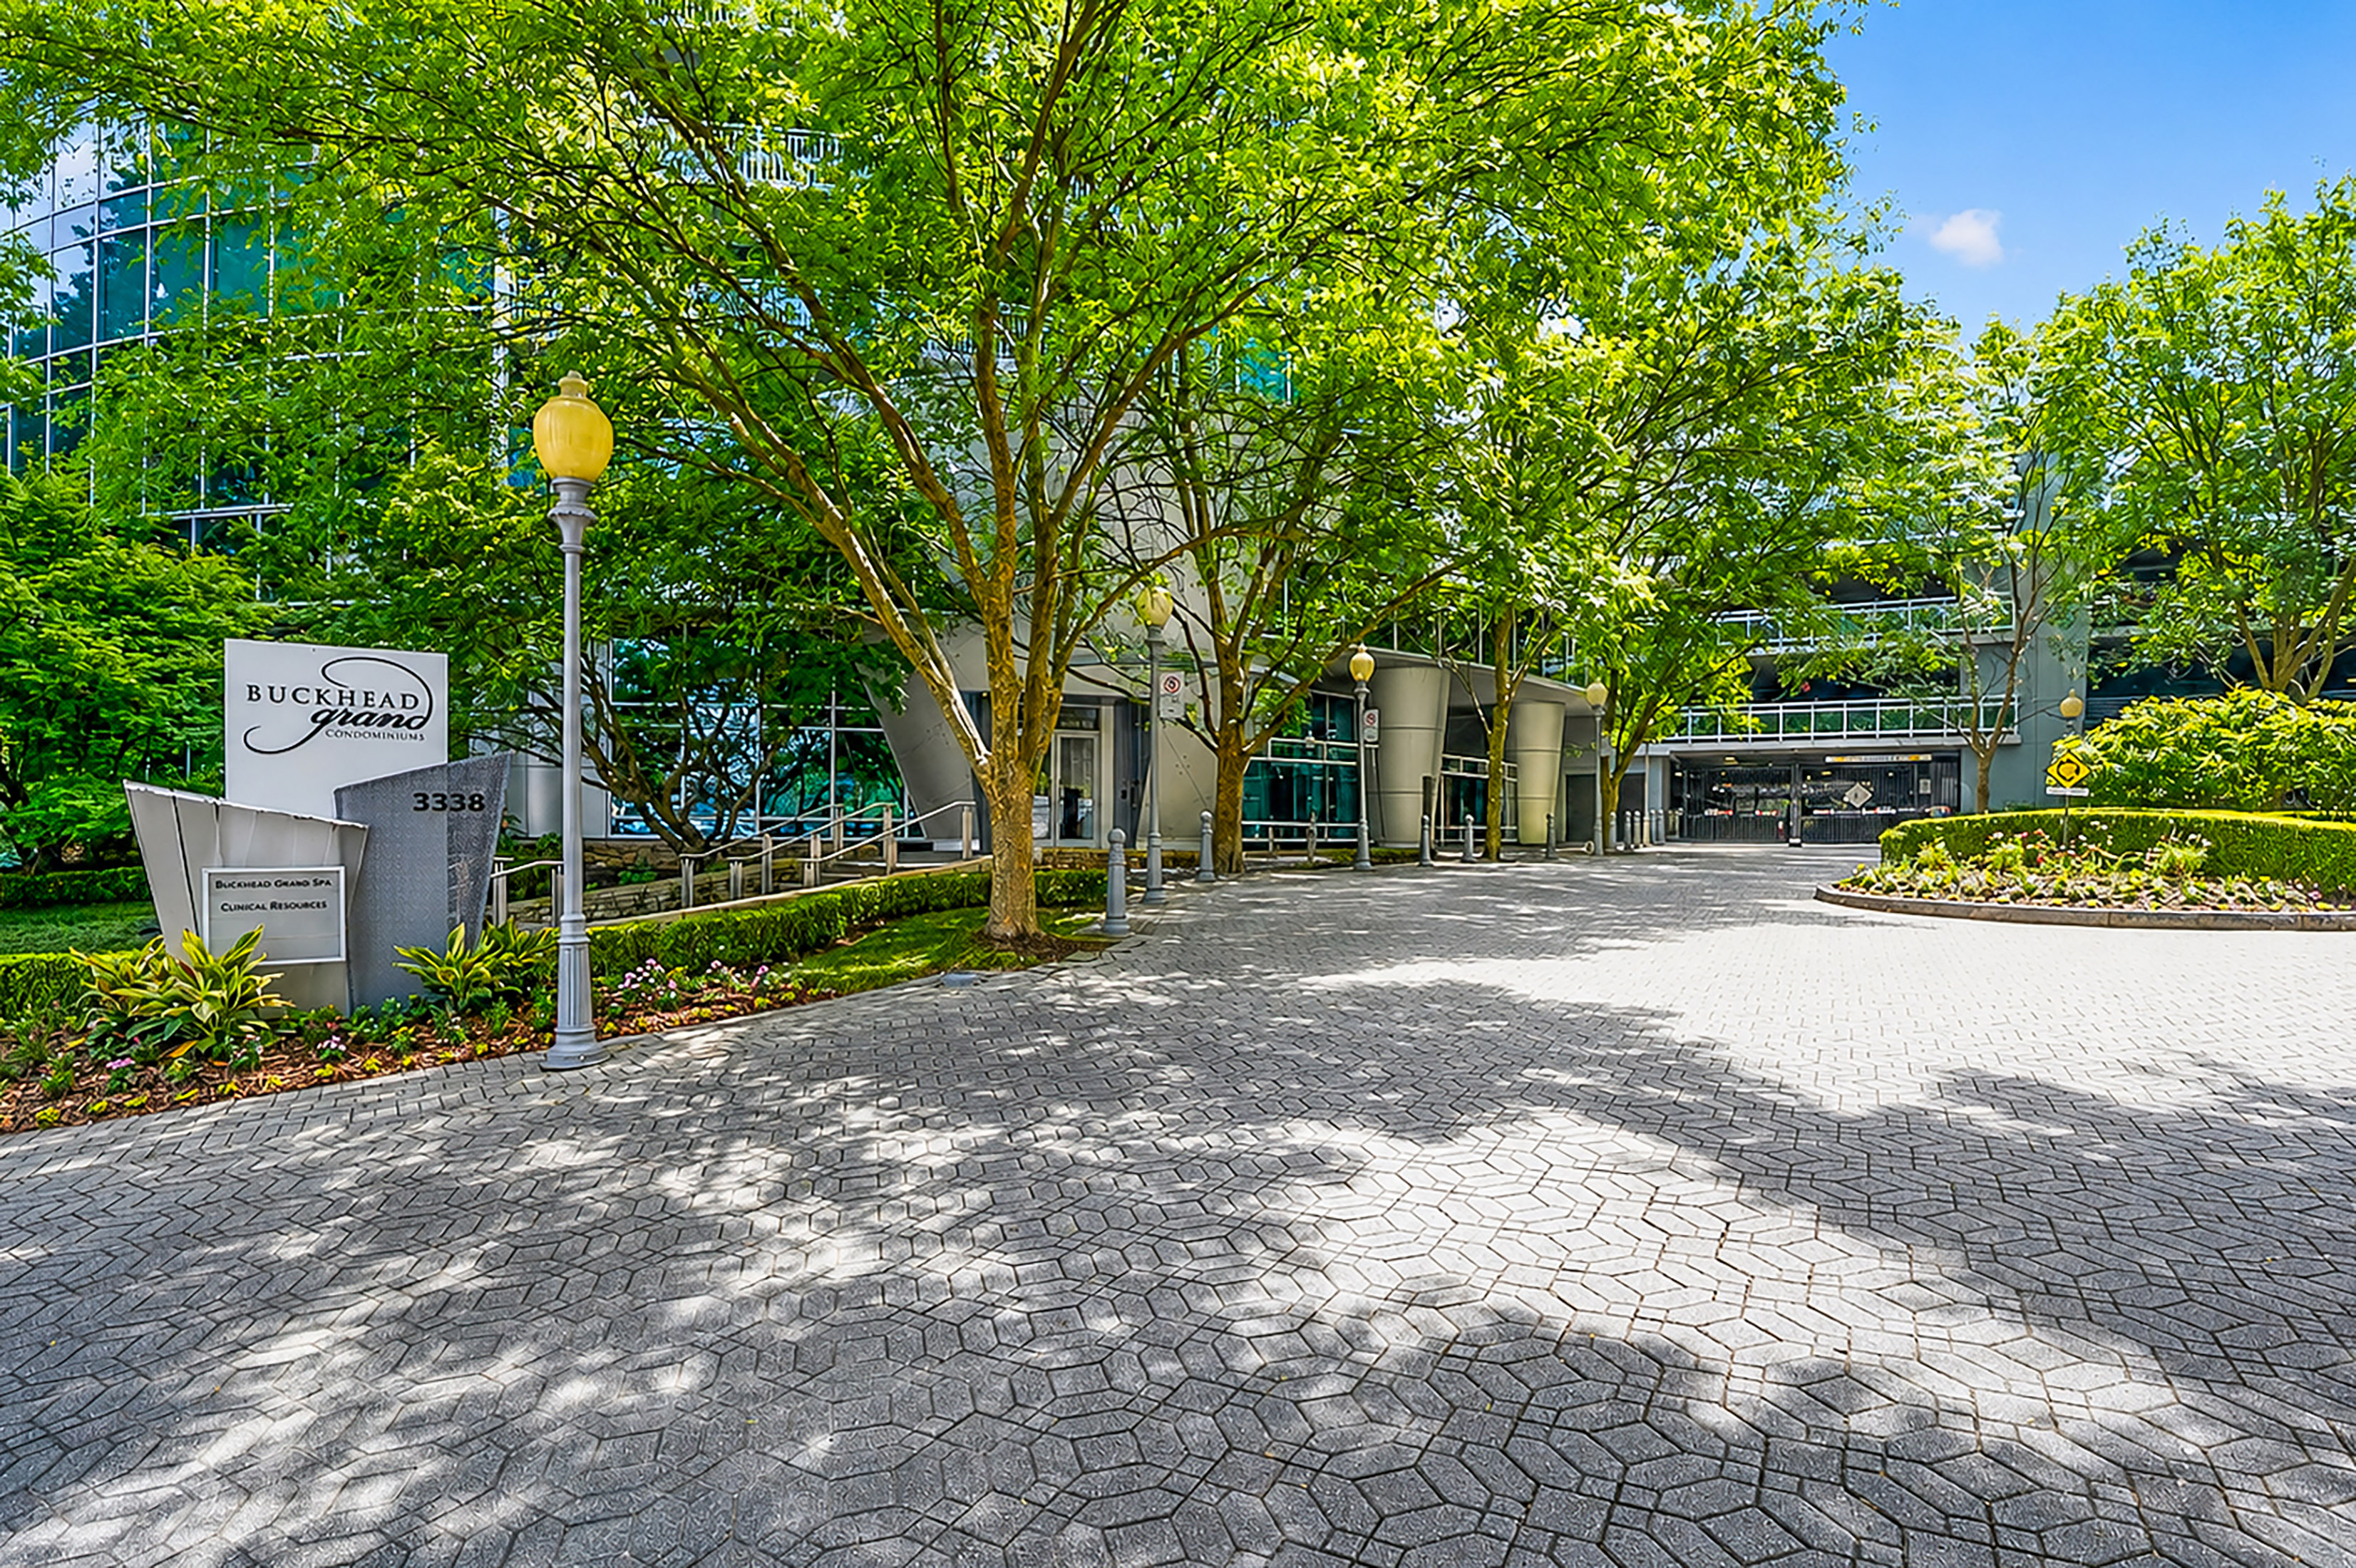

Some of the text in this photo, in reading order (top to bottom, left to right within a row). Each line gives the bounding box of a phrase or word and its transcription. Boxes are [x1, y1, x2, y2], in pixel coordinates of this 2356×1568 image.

[246, 684, 419, 710] BUCKHEAD
[324, 729, 426, 741] CONDOMINIUMS
[413, 793, 485, 812] 3338
[215, 877, 332, 889] BUCKHEAD GRAND SPA
[220, 900, 328, 912] CLINICAL RESOURCES
